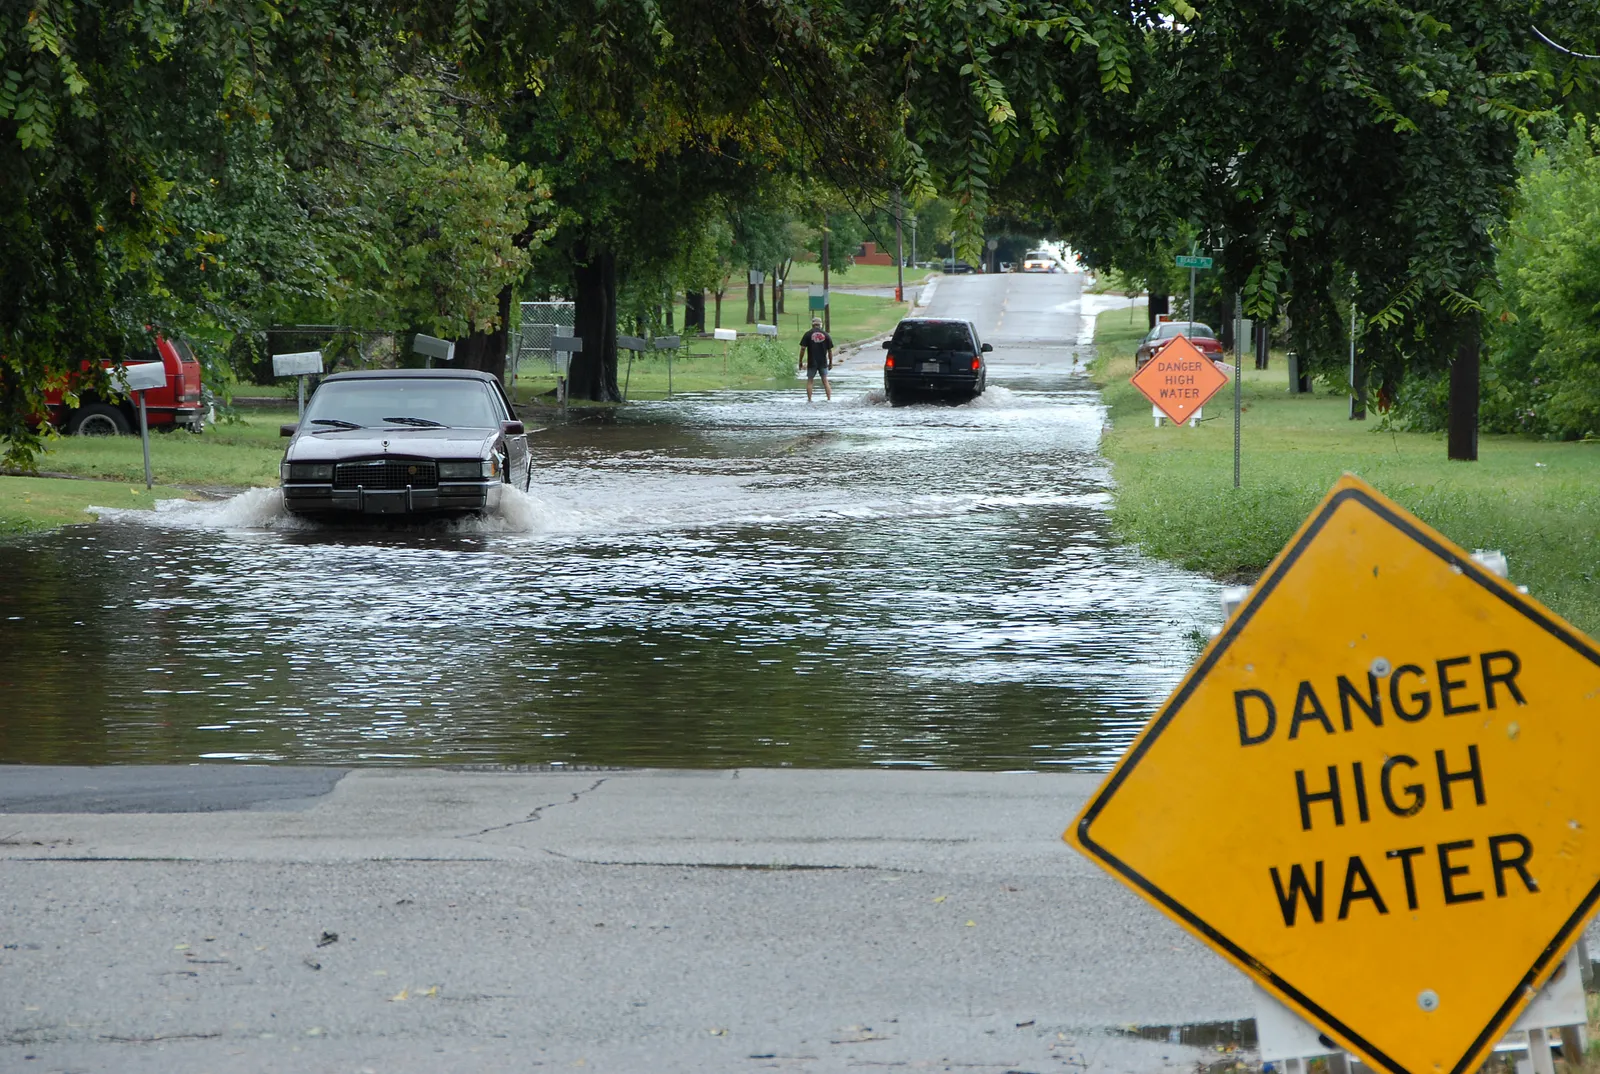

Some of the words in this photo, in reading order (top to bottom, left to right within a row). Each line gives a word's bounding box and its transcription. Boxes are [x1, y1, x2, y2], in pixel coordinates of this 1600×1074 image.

[1158, 361, 1202, 372] DANGER
[1165, 375, 1194, 385] HIGH
[1159, 388, 1200, 399] WATER
[1234, 650, 1528, 747] DANGER
[1295, 744, 1487, 831] HIGH
[1269, 832, 1540, 928] WATER
